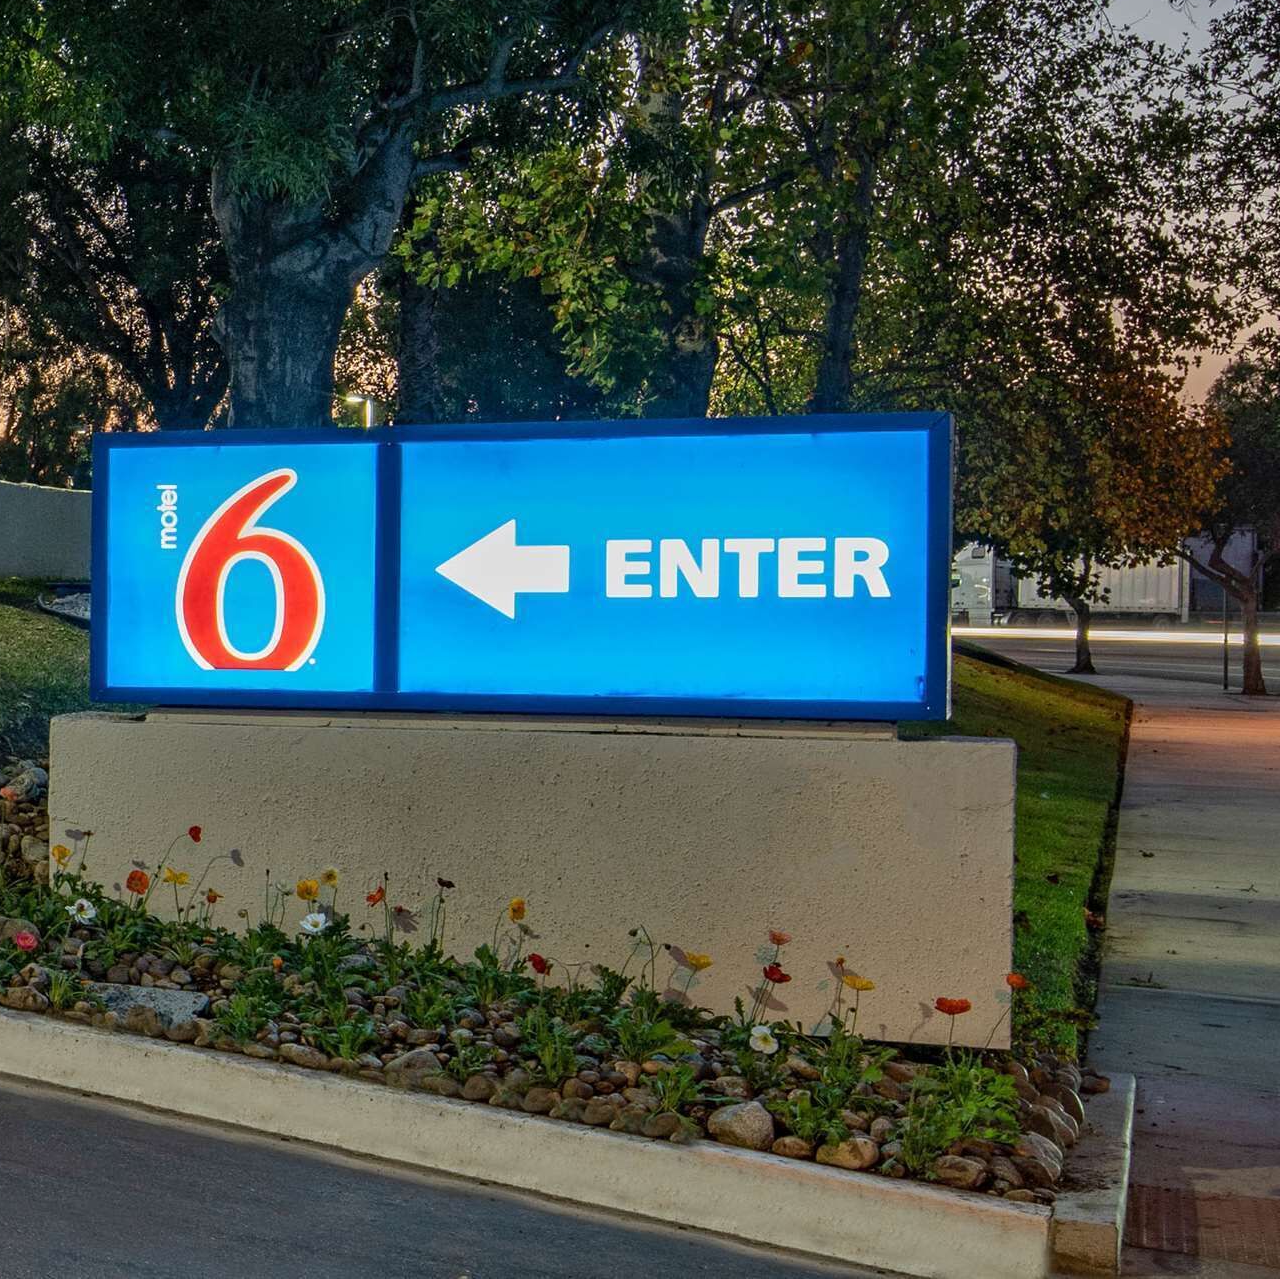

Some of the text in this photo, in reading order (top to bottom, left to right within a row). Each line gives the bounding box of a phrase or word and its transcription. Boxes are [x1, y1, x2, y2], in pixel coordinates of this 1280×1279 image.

[156, 468, 326, 671] motel 6
[605, 537, 891, 598] ENTER
